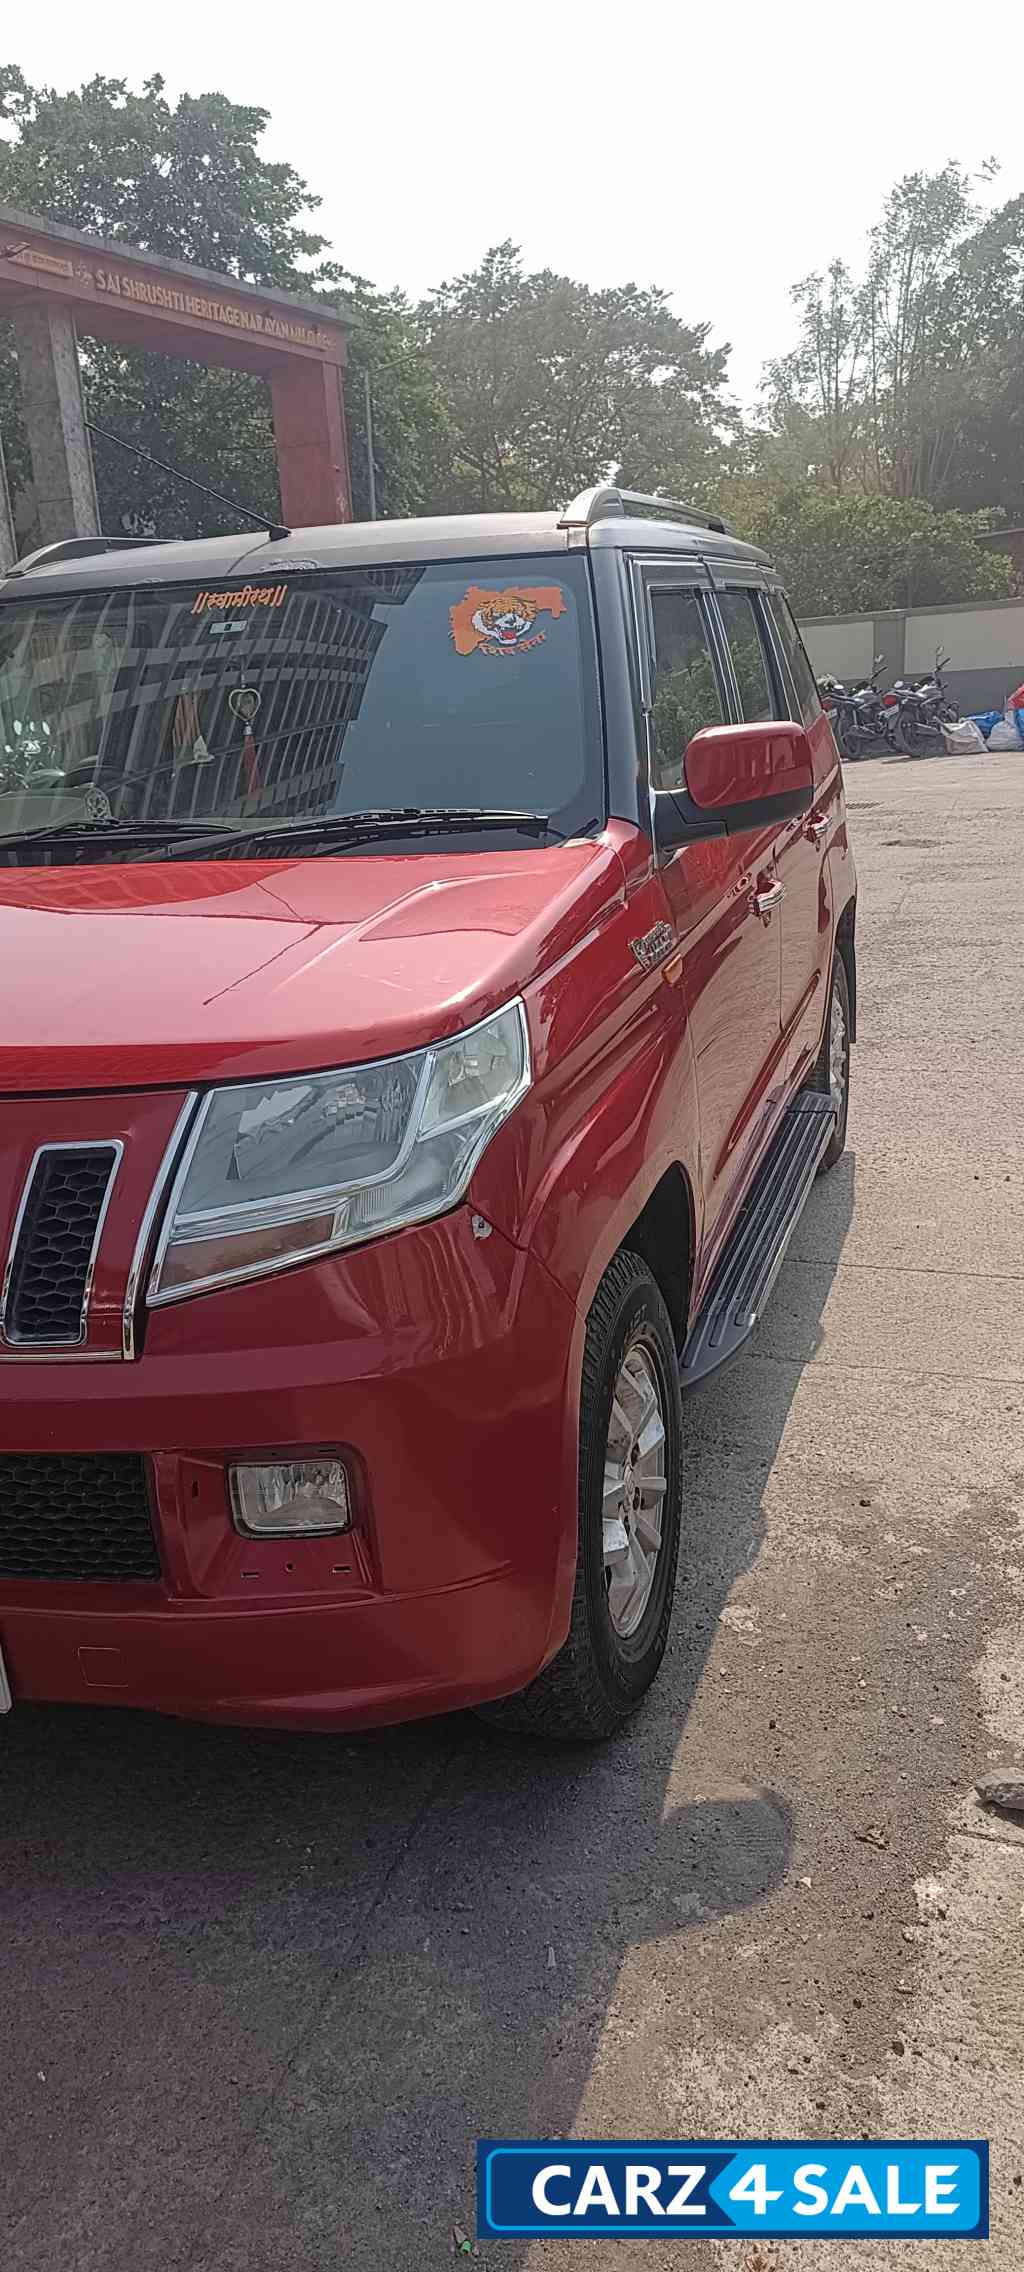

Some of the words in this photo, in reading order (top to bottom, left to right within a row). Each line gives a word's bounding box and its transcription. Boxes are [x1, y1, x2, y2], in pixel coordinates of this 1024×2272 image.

[96, 269, 121, 294] SAI
[122, 277, 184, 311] SHRUSHTI
[185, 295, 240, 326] HERITAGE
